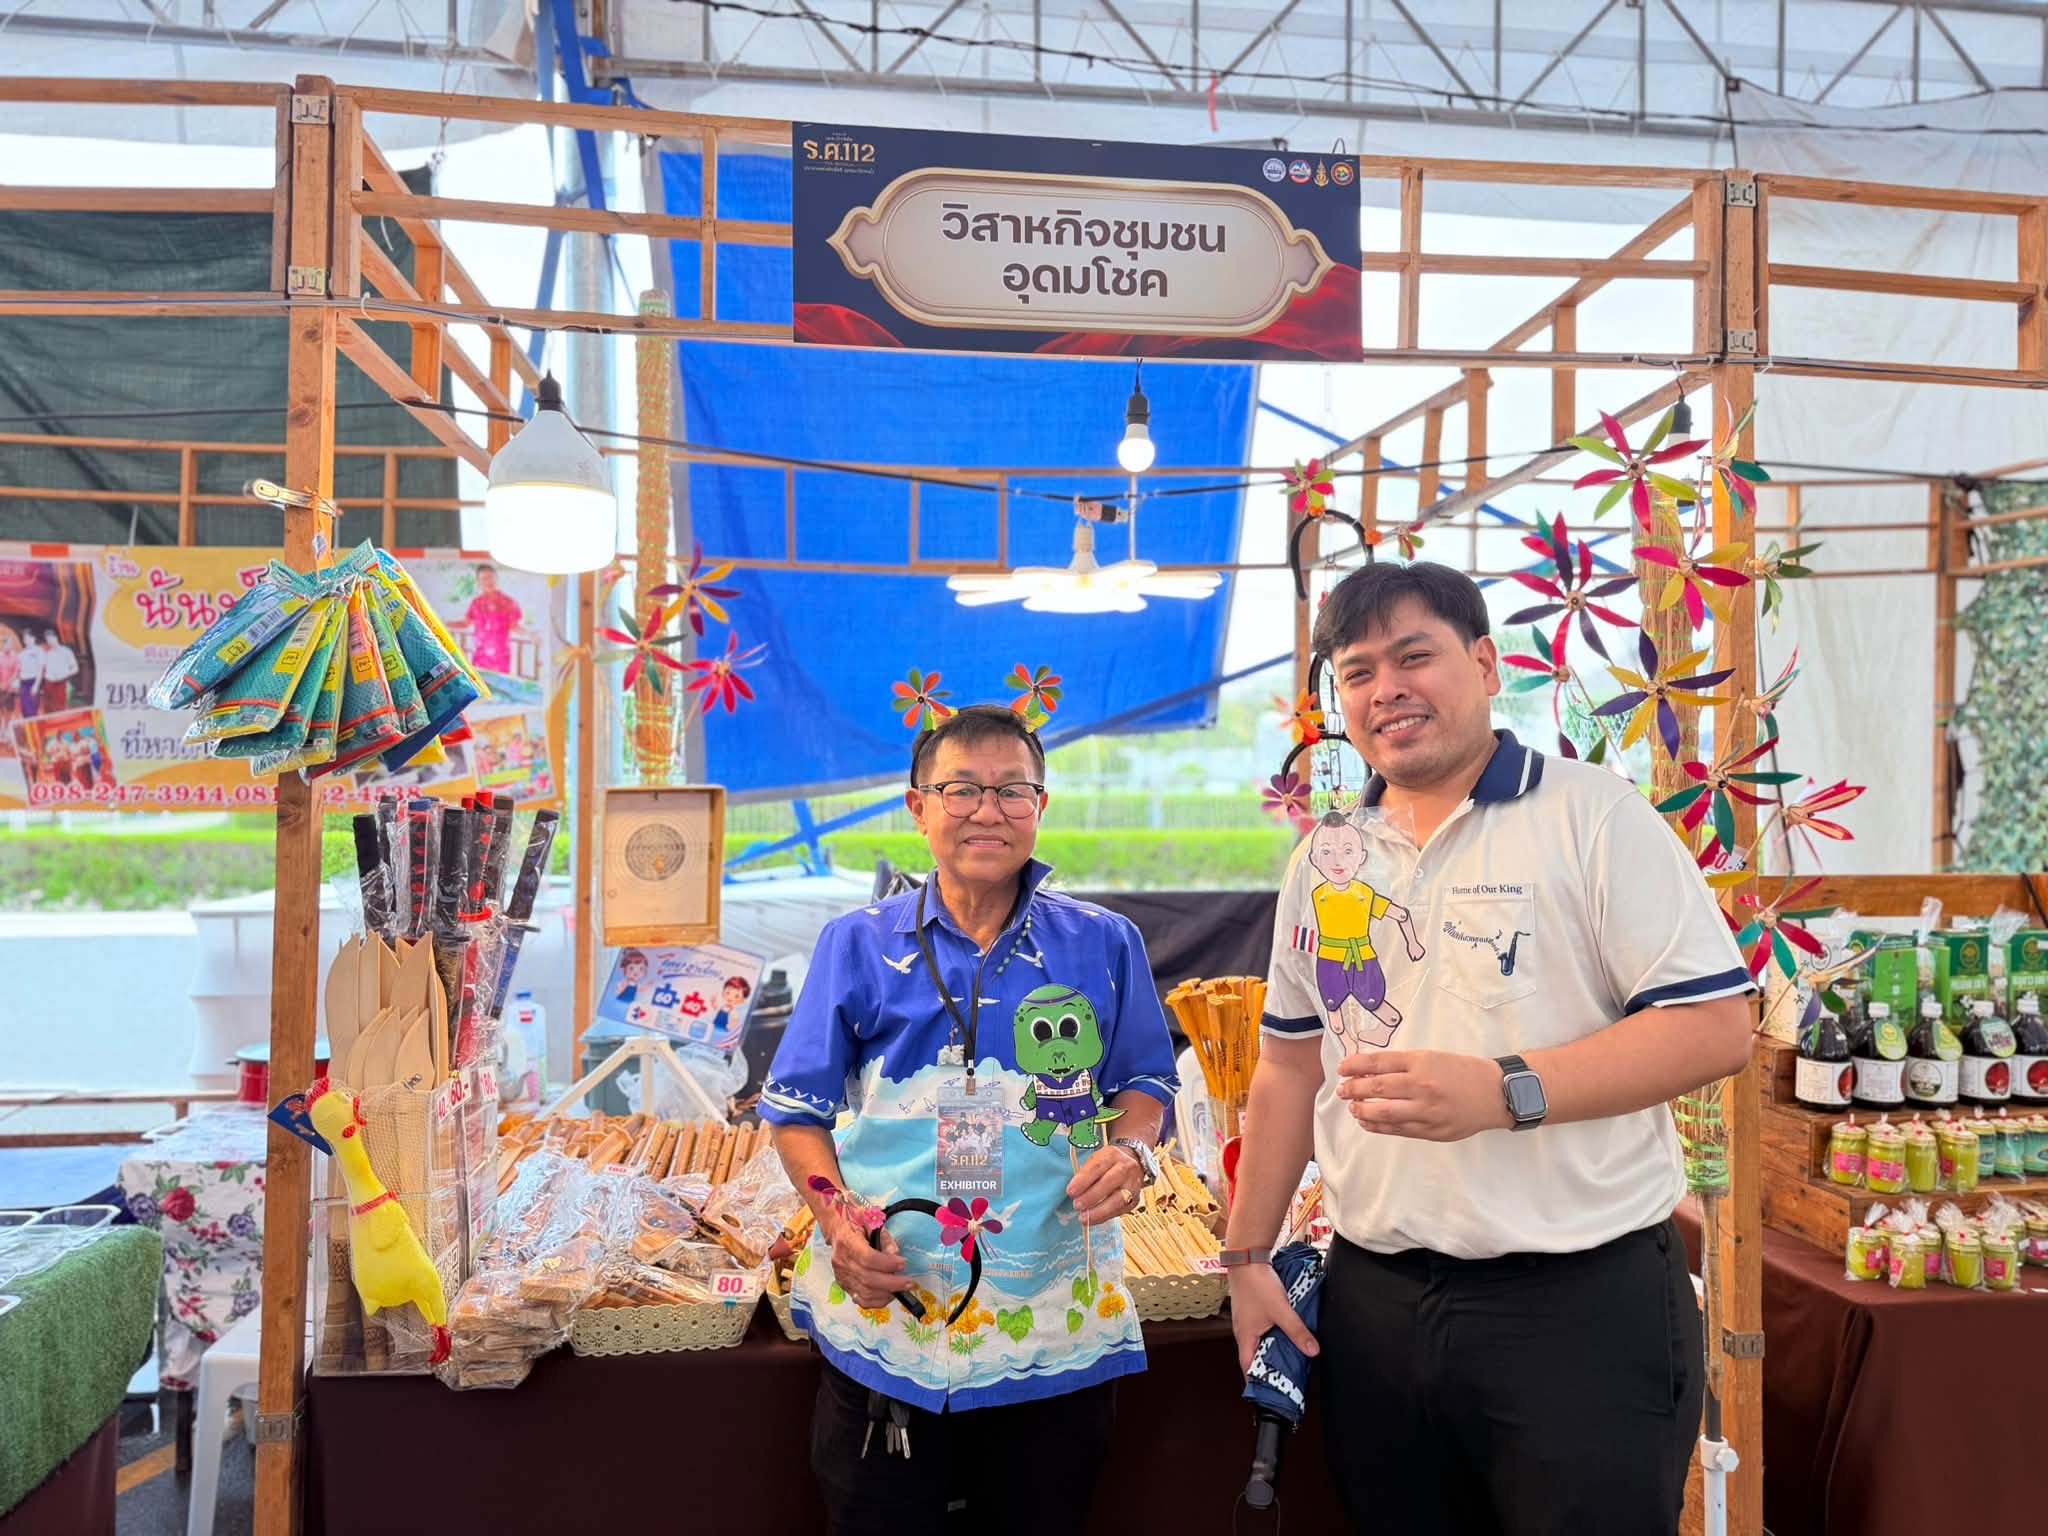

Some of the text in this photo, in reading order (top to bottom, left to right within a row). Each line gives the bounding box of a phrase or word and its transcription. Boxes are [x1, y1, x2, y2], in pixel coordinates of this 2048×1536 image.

[941, 203, 1226, 260] วิสาหกิจชุมชน
[1002, 256, 1169, 304] อุดมโชค
[1452, 884, 1523, 895] Home of Our King
[940, 1180, 997, 1190] EXHIBITOR
[717, 1276, 754, 1294] 80.-
